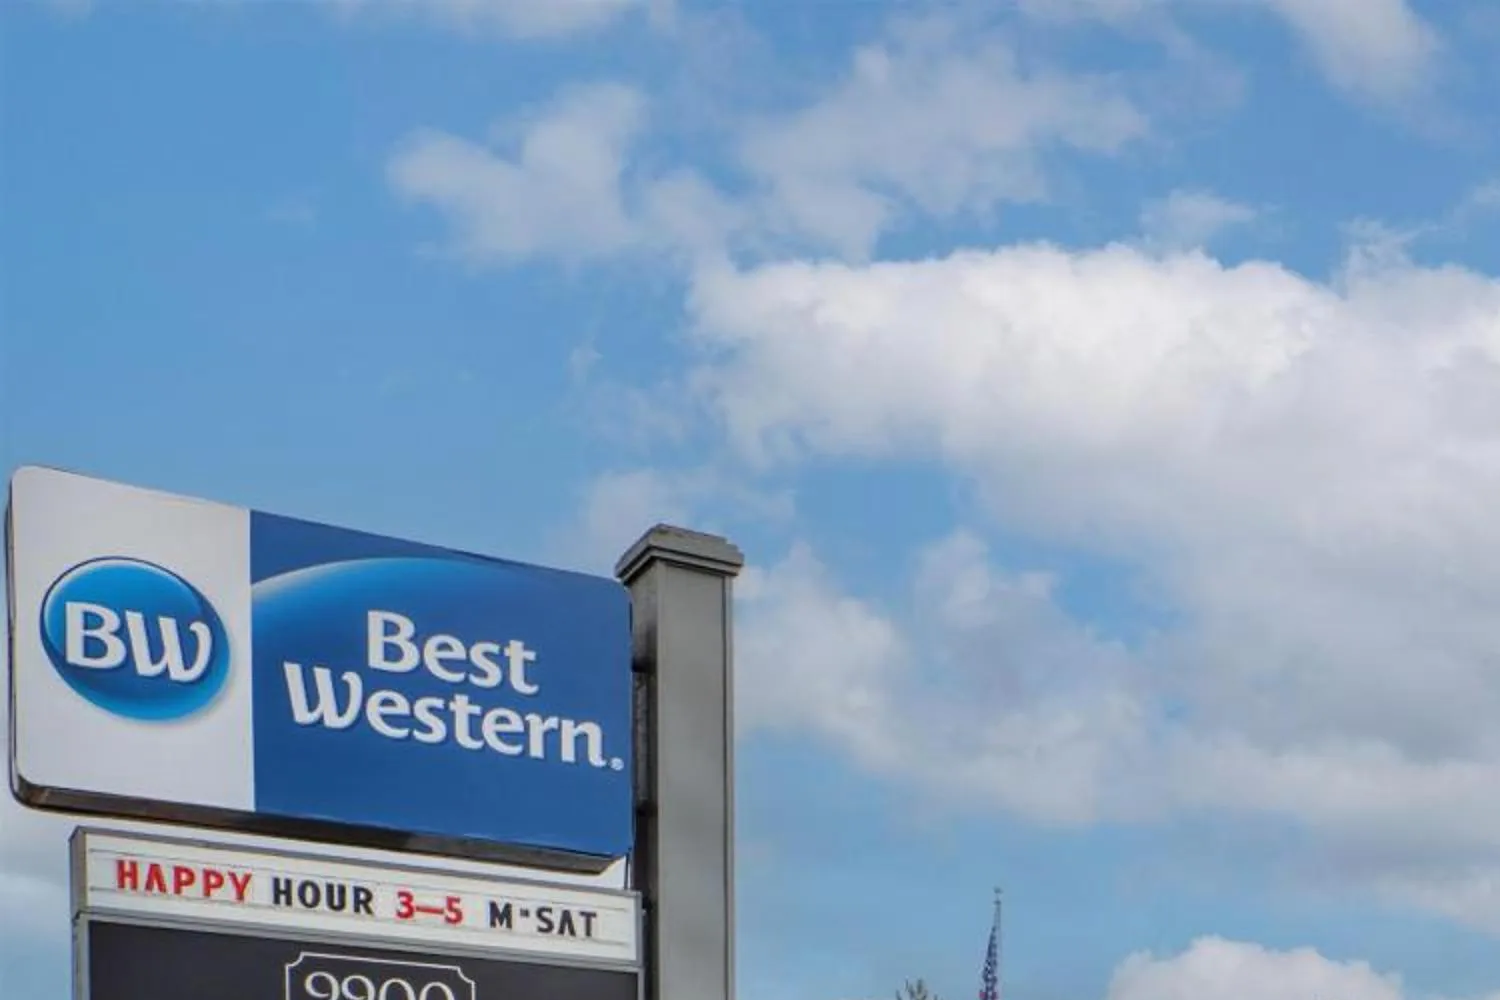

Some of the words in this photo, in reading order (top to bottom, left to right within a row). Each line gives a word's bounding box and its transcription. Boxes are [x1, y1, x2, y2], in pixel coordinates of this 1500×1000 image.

[65, 601, 212, 682] BW
[367, 610, 539, 694] Best
[116, 859, 252, 901] HAPPY
[272, 877, 374, 917] HOUR
